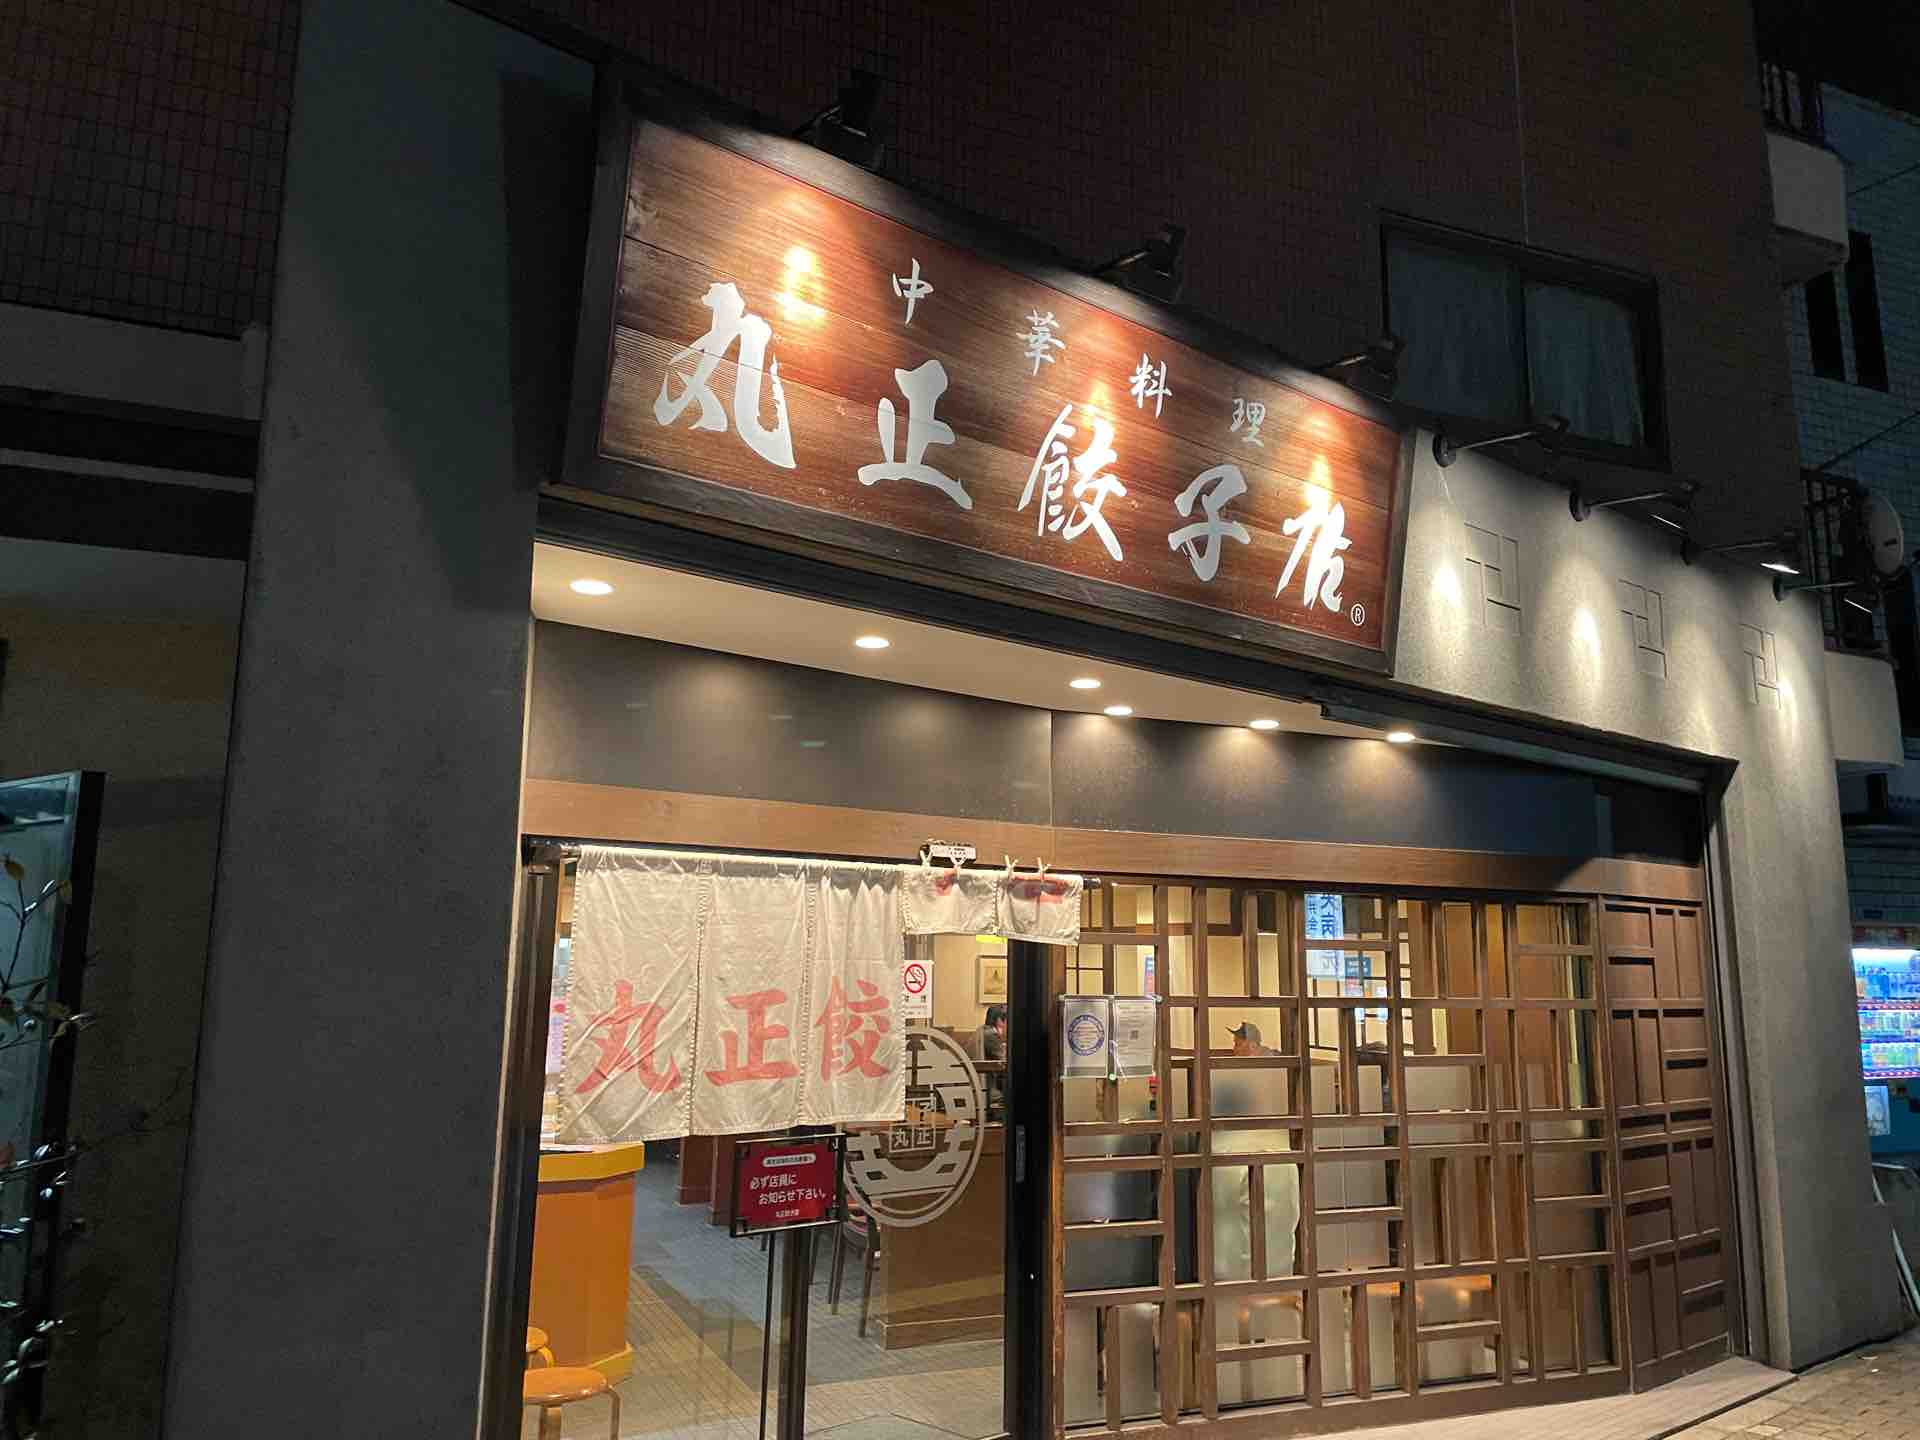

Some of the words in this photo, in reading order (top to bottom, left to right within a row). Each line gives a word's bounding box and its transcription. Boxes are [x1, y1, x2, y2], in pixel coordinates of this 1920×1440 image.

[654, 282, 1353, 612] 丸正餃子店
[892, 257, 1266, 447] 中華料理
[750, 1173, 798, 1190] 必ず店員に
